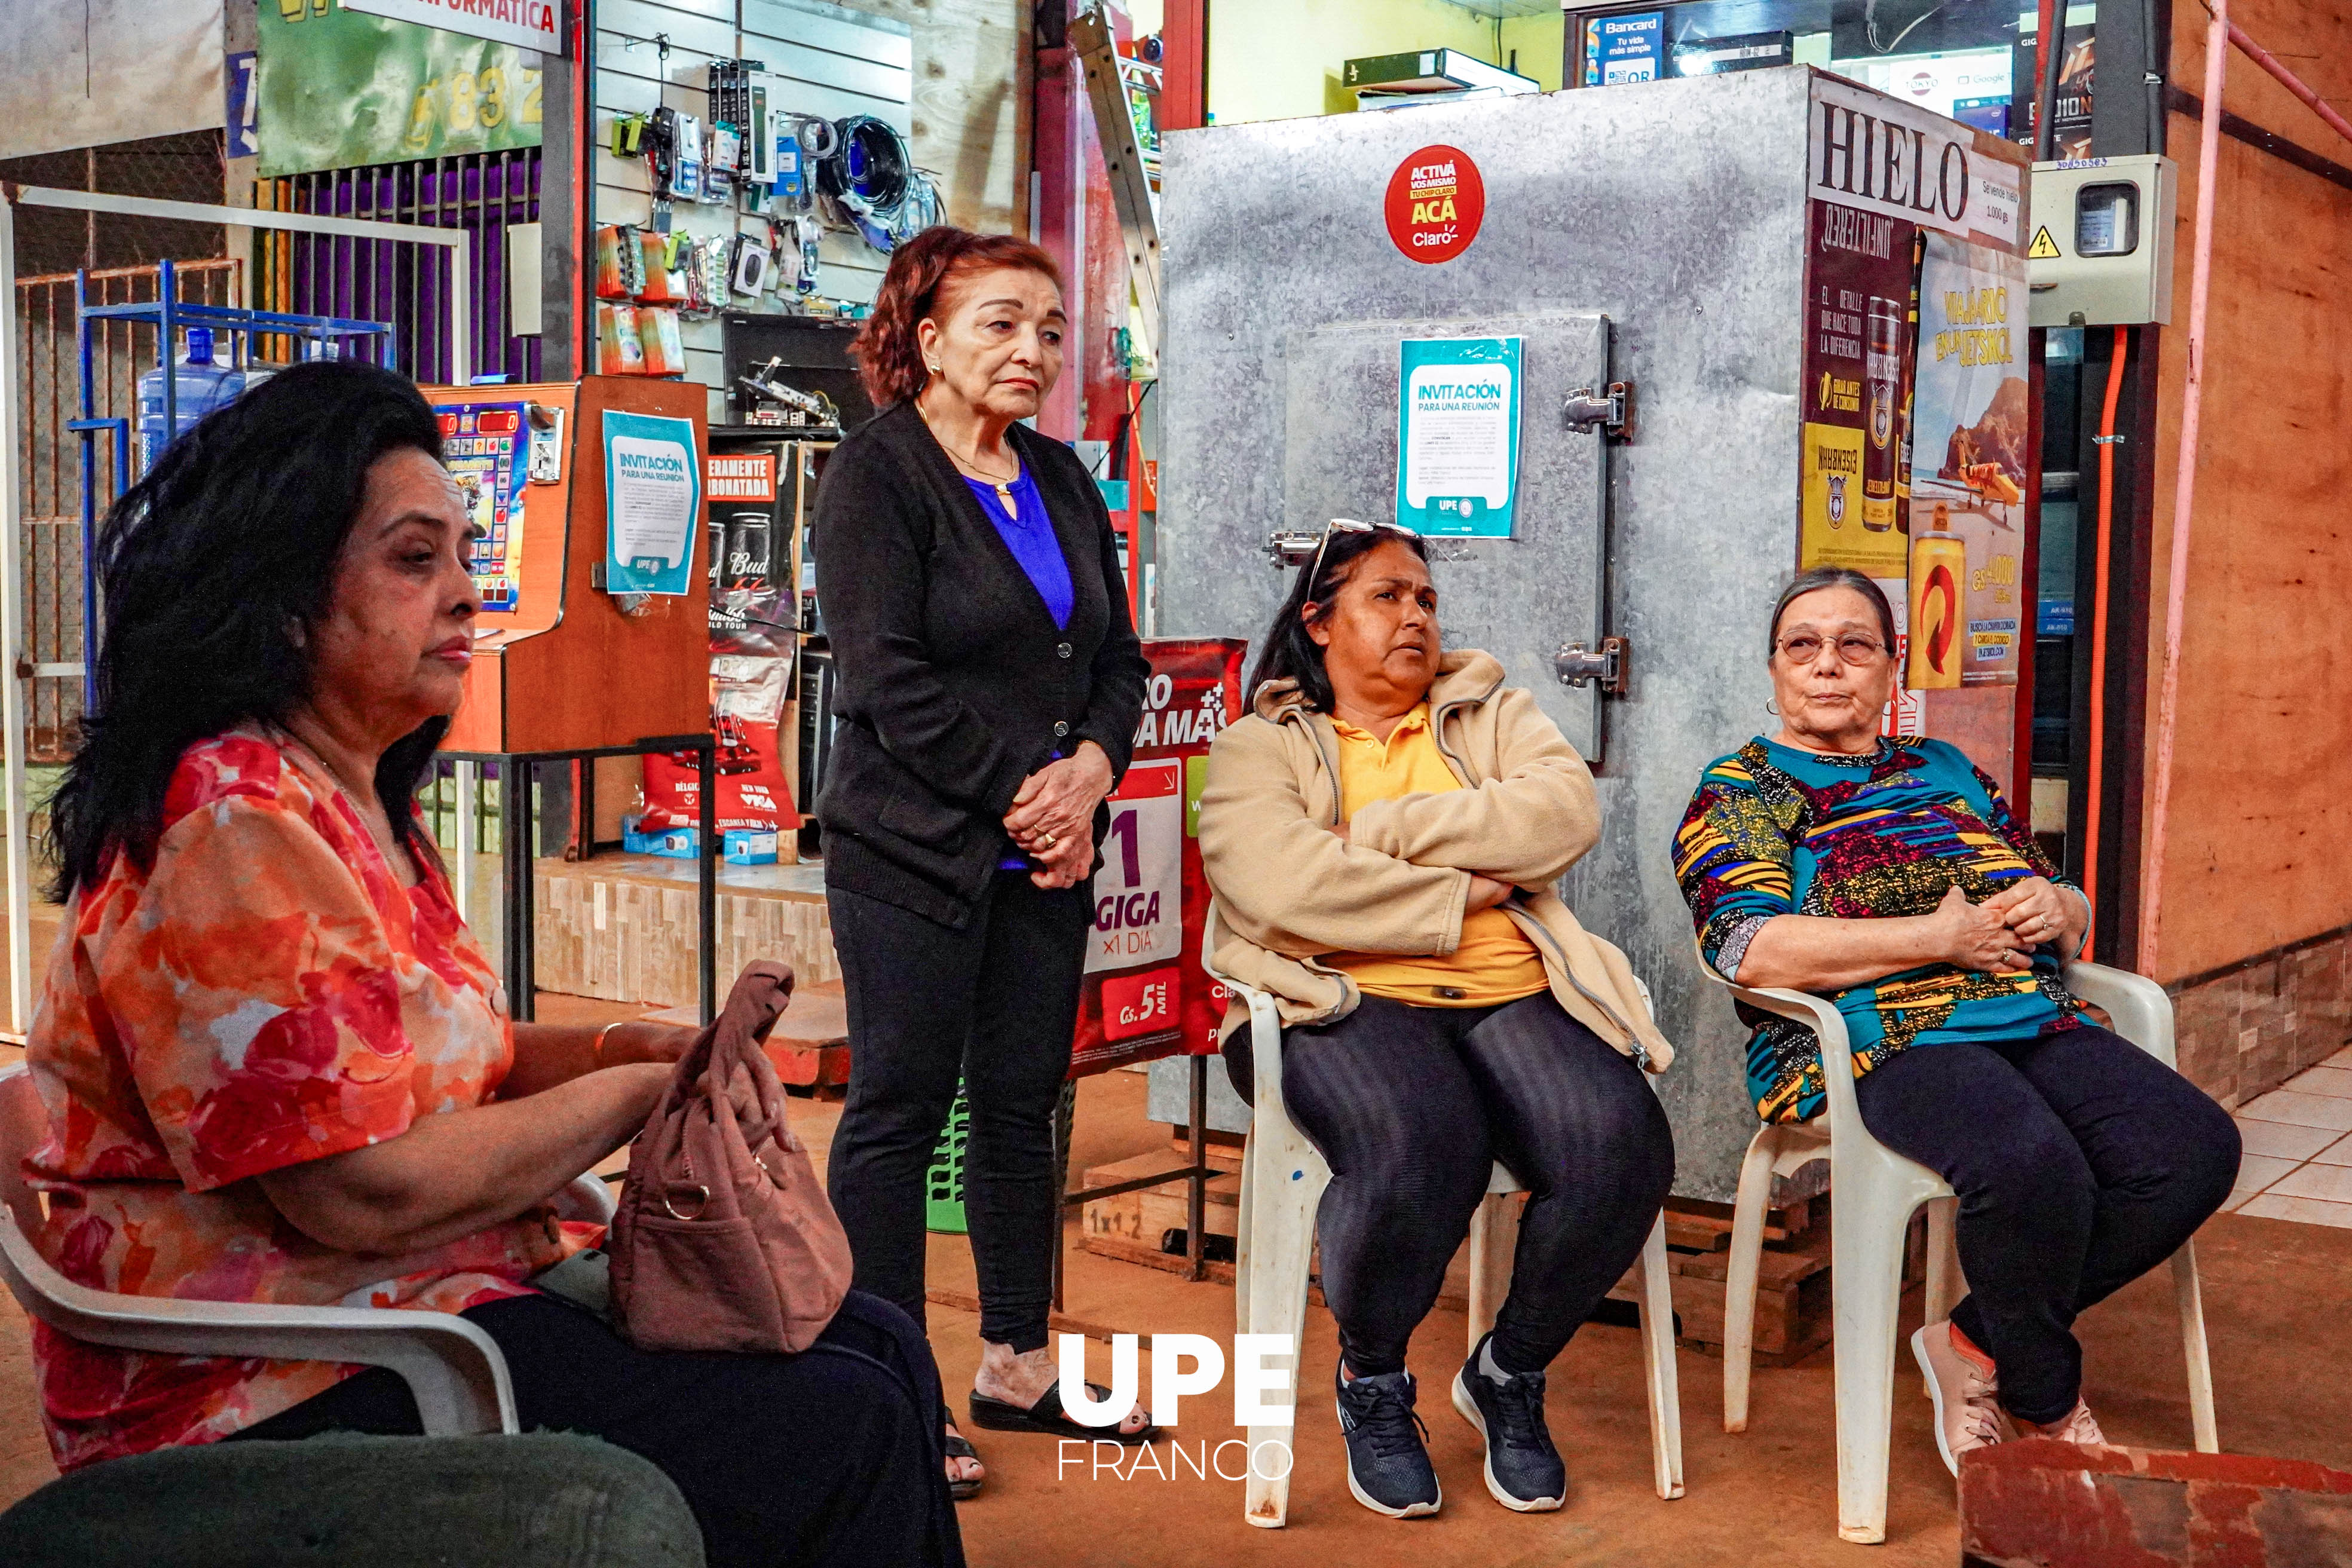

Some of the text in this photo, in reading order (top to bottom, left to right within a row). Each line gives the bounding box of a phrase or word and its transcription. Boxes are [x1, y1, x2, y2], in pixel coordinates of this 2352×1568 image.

[1606, 19, 1657, 34] Bancard
[1617, 36, 1644, 46] Tu vida
[1627, 45, 1652, 55] simple
[1904, 78, 1938, 90] TOKYO
[1973, 73, 2005, 85] Google
[1411, 160, 1457, 181] ACTIVÁ
[1817, 100, 1970, 223] HIELO
[1411, 177, 1457, 189] VOS MISMO
[1435, 187, 1455, 195] CLARO
[1983, 180, 2019, 203] Se vende hielo
[1411, 195, 1458, 225] ACÁ
[1412, 230, 1453, 247] Claro
[1822, 285, 1863, 313] EL DETALLE
[1821, 310, 1832, 331] QUE
[1832, 311, 1847, 334] HACE
[1820, 334, 1829, 354] LA
[1417, 379, 1502, 400] INVITACIÓN
[1418, 400, 1500, 412] PARA UNA REUNIÓN
[619, 453, 683, 473] INVITACIÓN
[1818, 445, 1858, 475] EISENBAHN
[621, 470, 685, 483] PARA UNA REUNIÓN
[1439, 500, 1457, 511] UPE
[636, 559, 650, 569] UPE
[729, 552, 770, 575] Bud
[675, 781, 700, 792] BÉLGIC
[1111, 809, 1141, 889] 1
[1095, 890, 1160, 933] GIGA
[1140, 983, 1156, 1021] 5
[1156, 981, 1167, 1015] MIL
